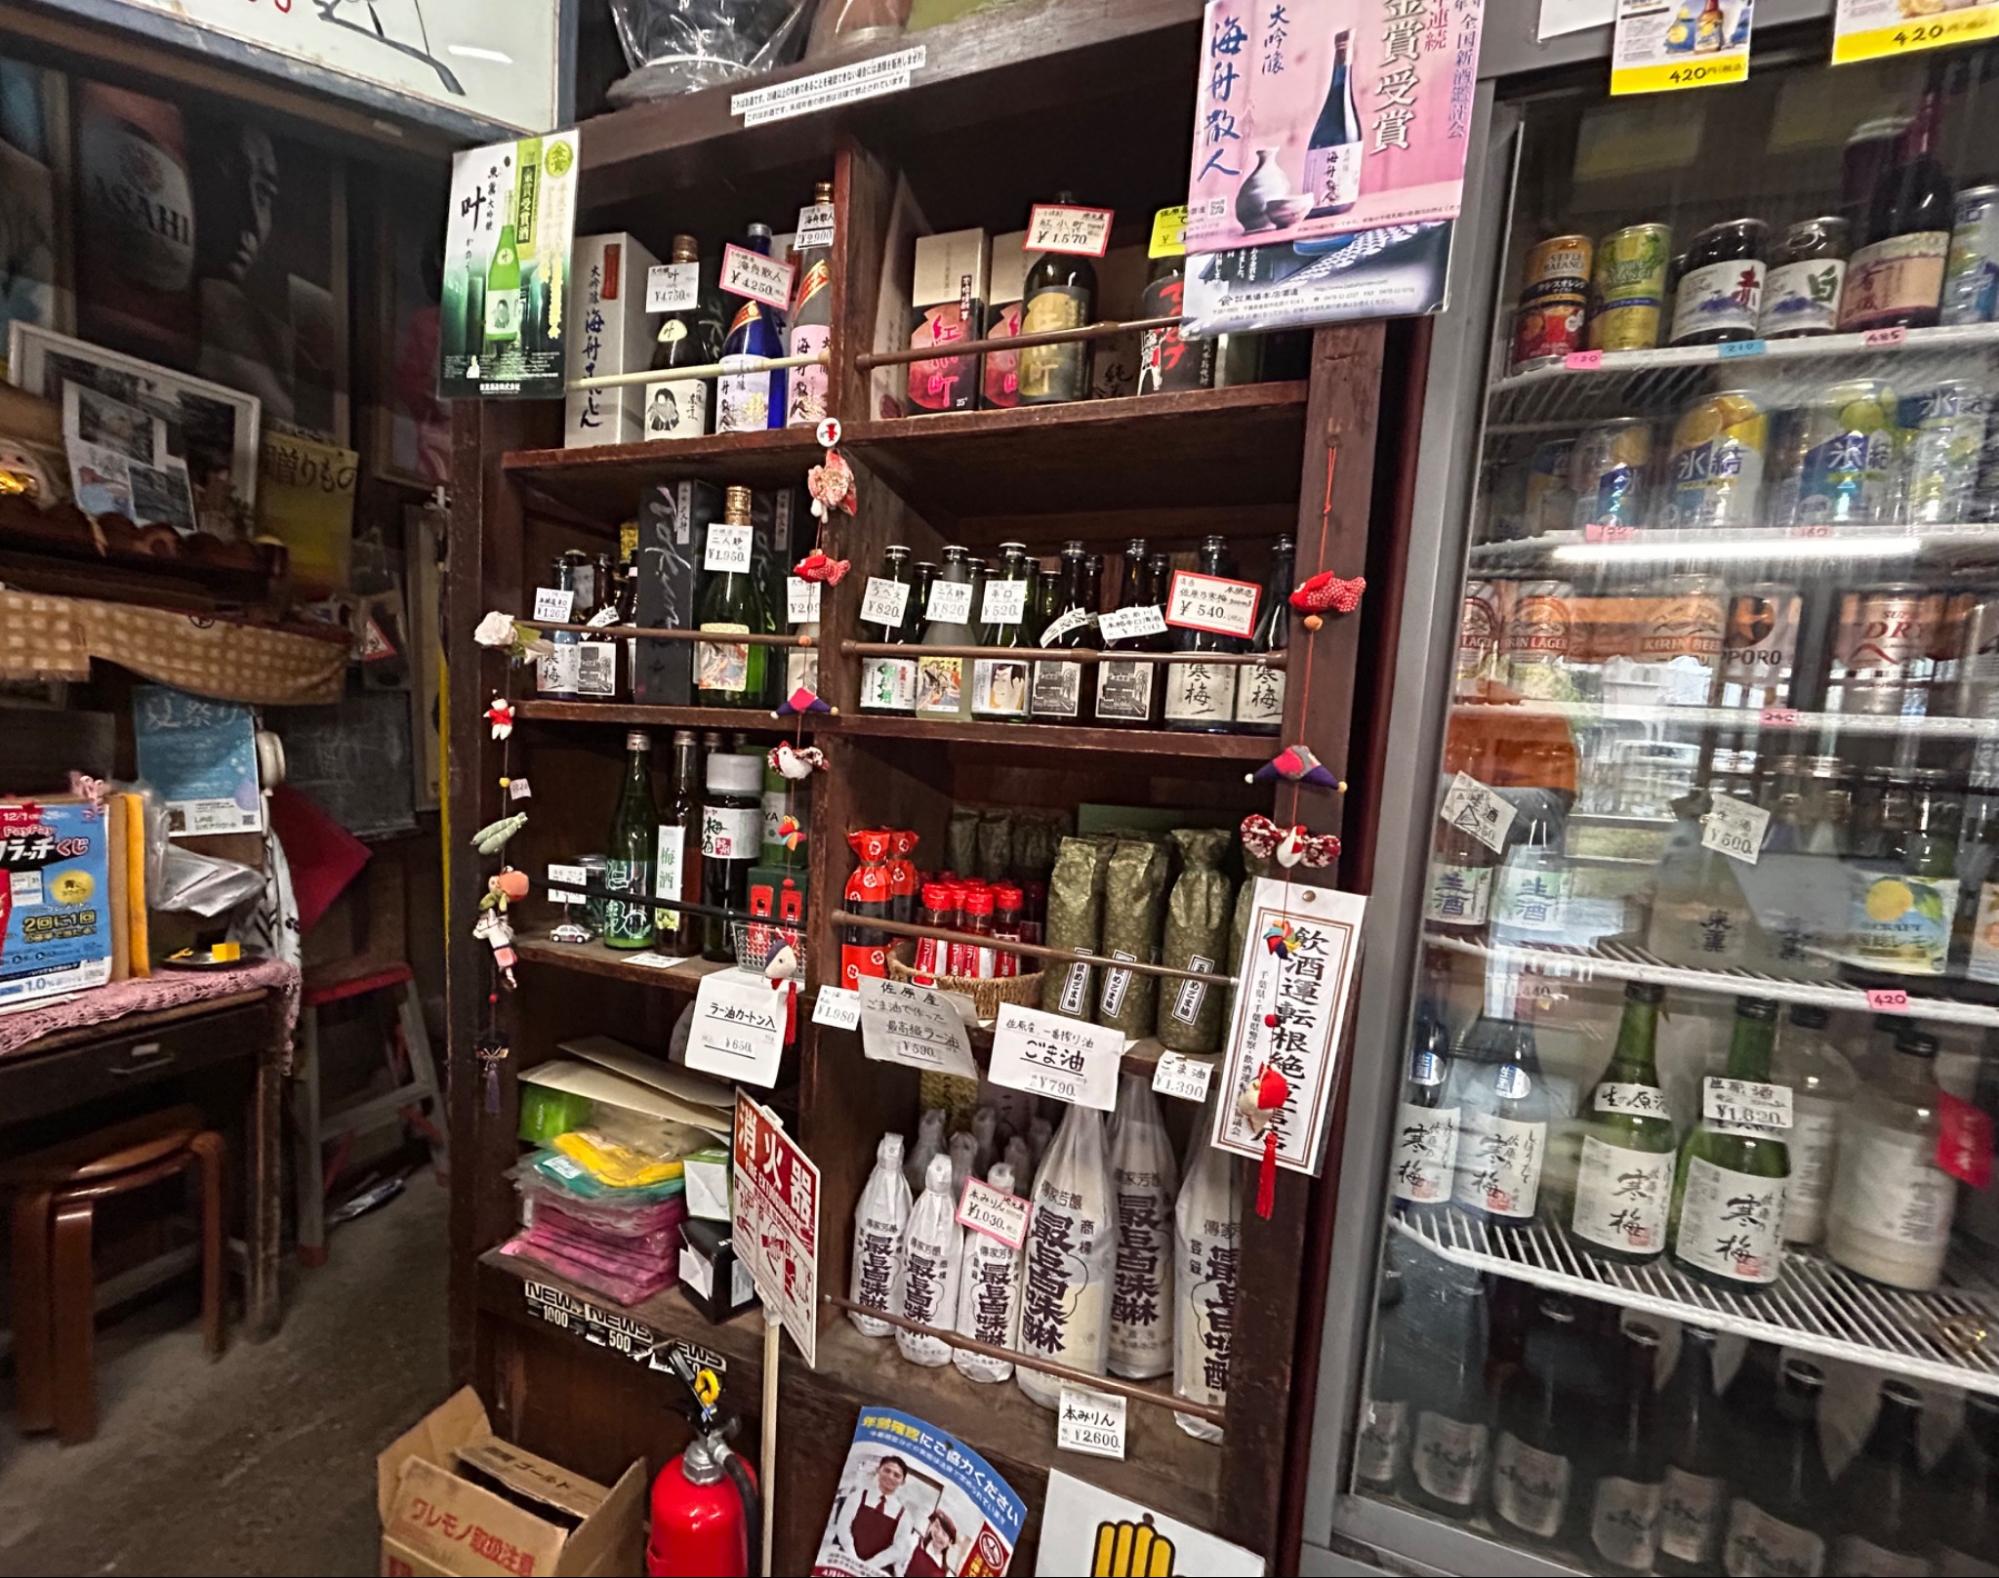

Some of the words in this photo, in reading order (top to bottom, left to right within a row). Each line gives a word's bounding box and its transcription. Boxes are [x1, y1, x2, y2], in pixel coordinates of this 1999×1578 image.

[659, 846, 675, 889] 梅酒
[880, 981, 940, 1007] 佐原産
[1874, 994, 1907, 1006] 420
[1025, 1039, 1085, 1072] ごま油
[738, 1101, 813, 1233] 消火器
[1398, 1122, 1429, 1188] 寒梅
[1609, 1168, 1650, 1237] 寒梅
[1715, 1193, 1762, 1264] 寒梅
[589, 1310, 652, 1342] NEWS
[608, 1330, 632, 1353] 500
[676, 1340, 725, 1369] EWS
[1062, 1404, 1116, 1428] 本みりん
